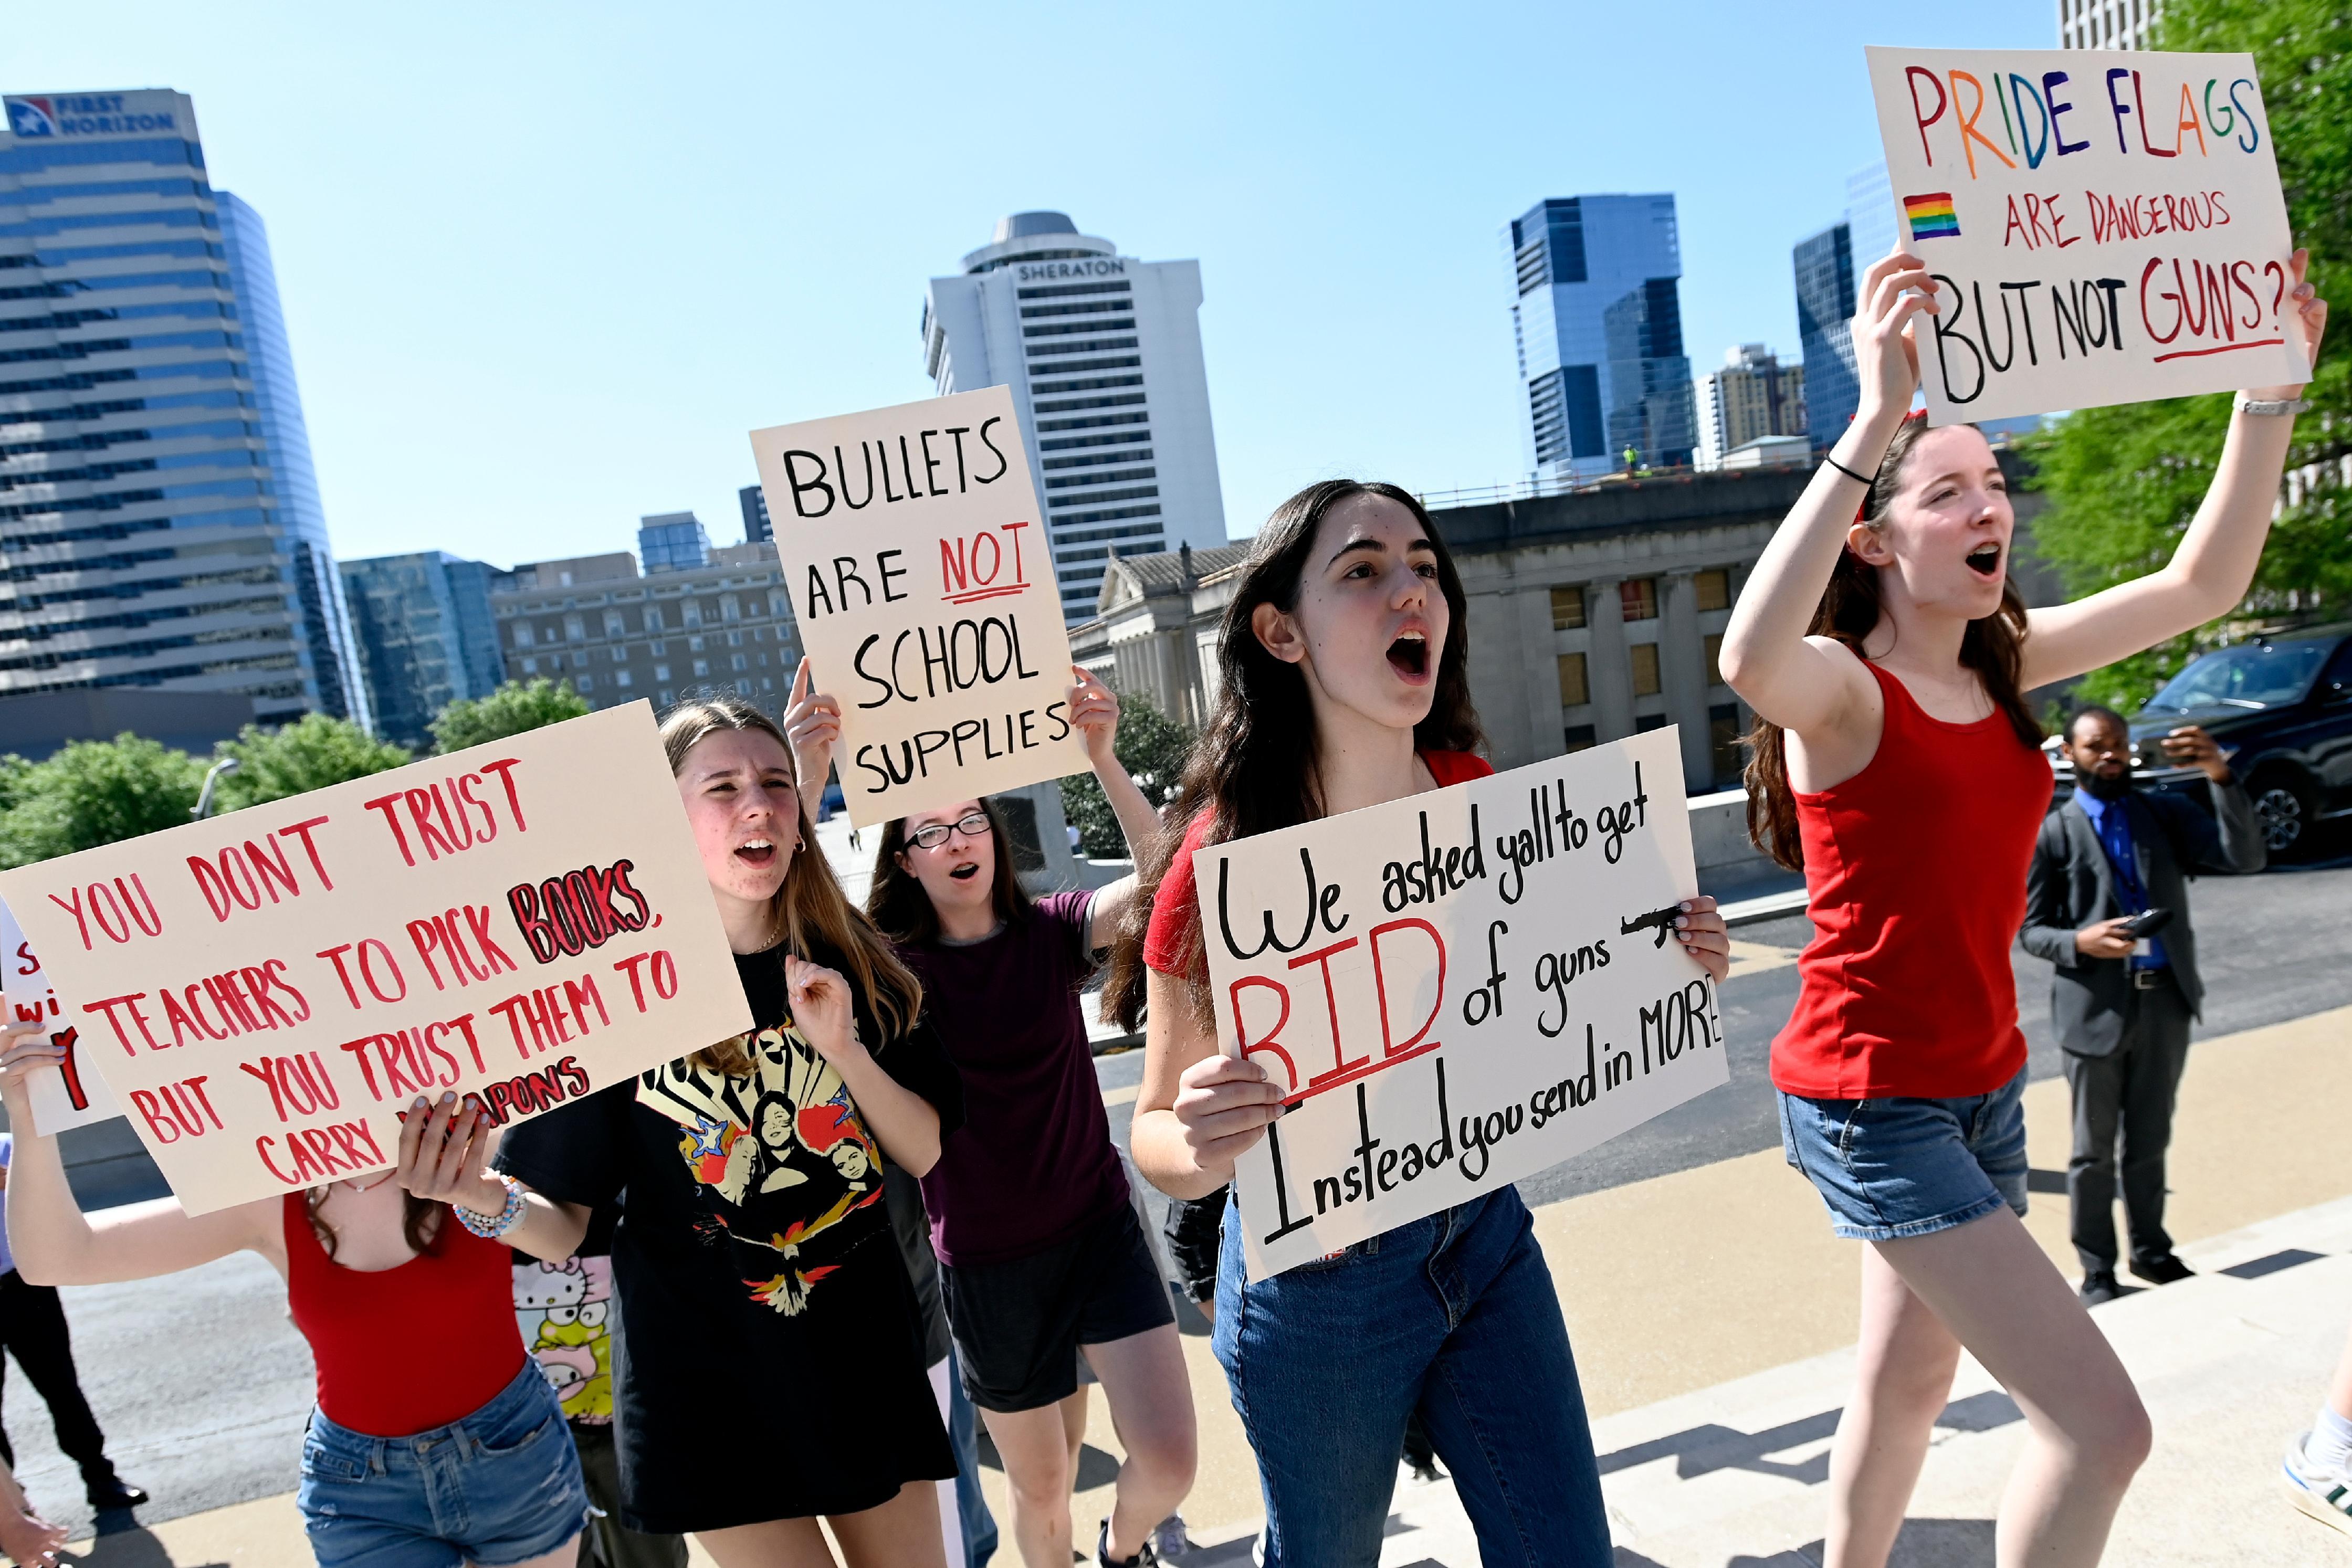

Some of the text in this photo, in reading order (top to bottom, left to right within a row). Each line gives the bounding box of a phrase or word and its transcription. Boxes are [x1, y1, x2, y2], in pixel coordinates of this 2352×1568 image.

[55, 96, 124, 113] FIRST
[60, 114, 174, 135] HORIZON
[1905, 66, 2258, 180] PRIDE FLAGS
[1019, 259, 1125, 281] SHERATON
[2004, 190, 2230, 250] ARE DANGEROUS
[1929, 257, 2285, 404] BUT NOT GUNS?
[783, 416, 1007, 517] BULLETS
[808, 521, 1029, 618] ARE NOT
[854, 614, 1038, 709] SCHOOL
[856, 701, 1069, 793] SUPPLIES
[48, 759, 526, 950] YOU DONT TRUST
[1218, 848, 1349, 960] We
[1382, 804, 1486, 913] asked
[1597, 761, 1647, 864] get
[14, 989, 60, 1023] wi
[16, 941, 40, 975] S
[82, 859, 662, 1056] TEACHERS TO PICK BOOKS,
[1229, 918, 1610, 1092] RID of guns
[130, 950, 677, 1143] BUT YOU TRUST THEM TO
[256, 1118, 386, 1185] CARRY
[396, 1056, 590, 1142] APONS
[1265, 973, 1721, 1245] Instead you send in MORE
